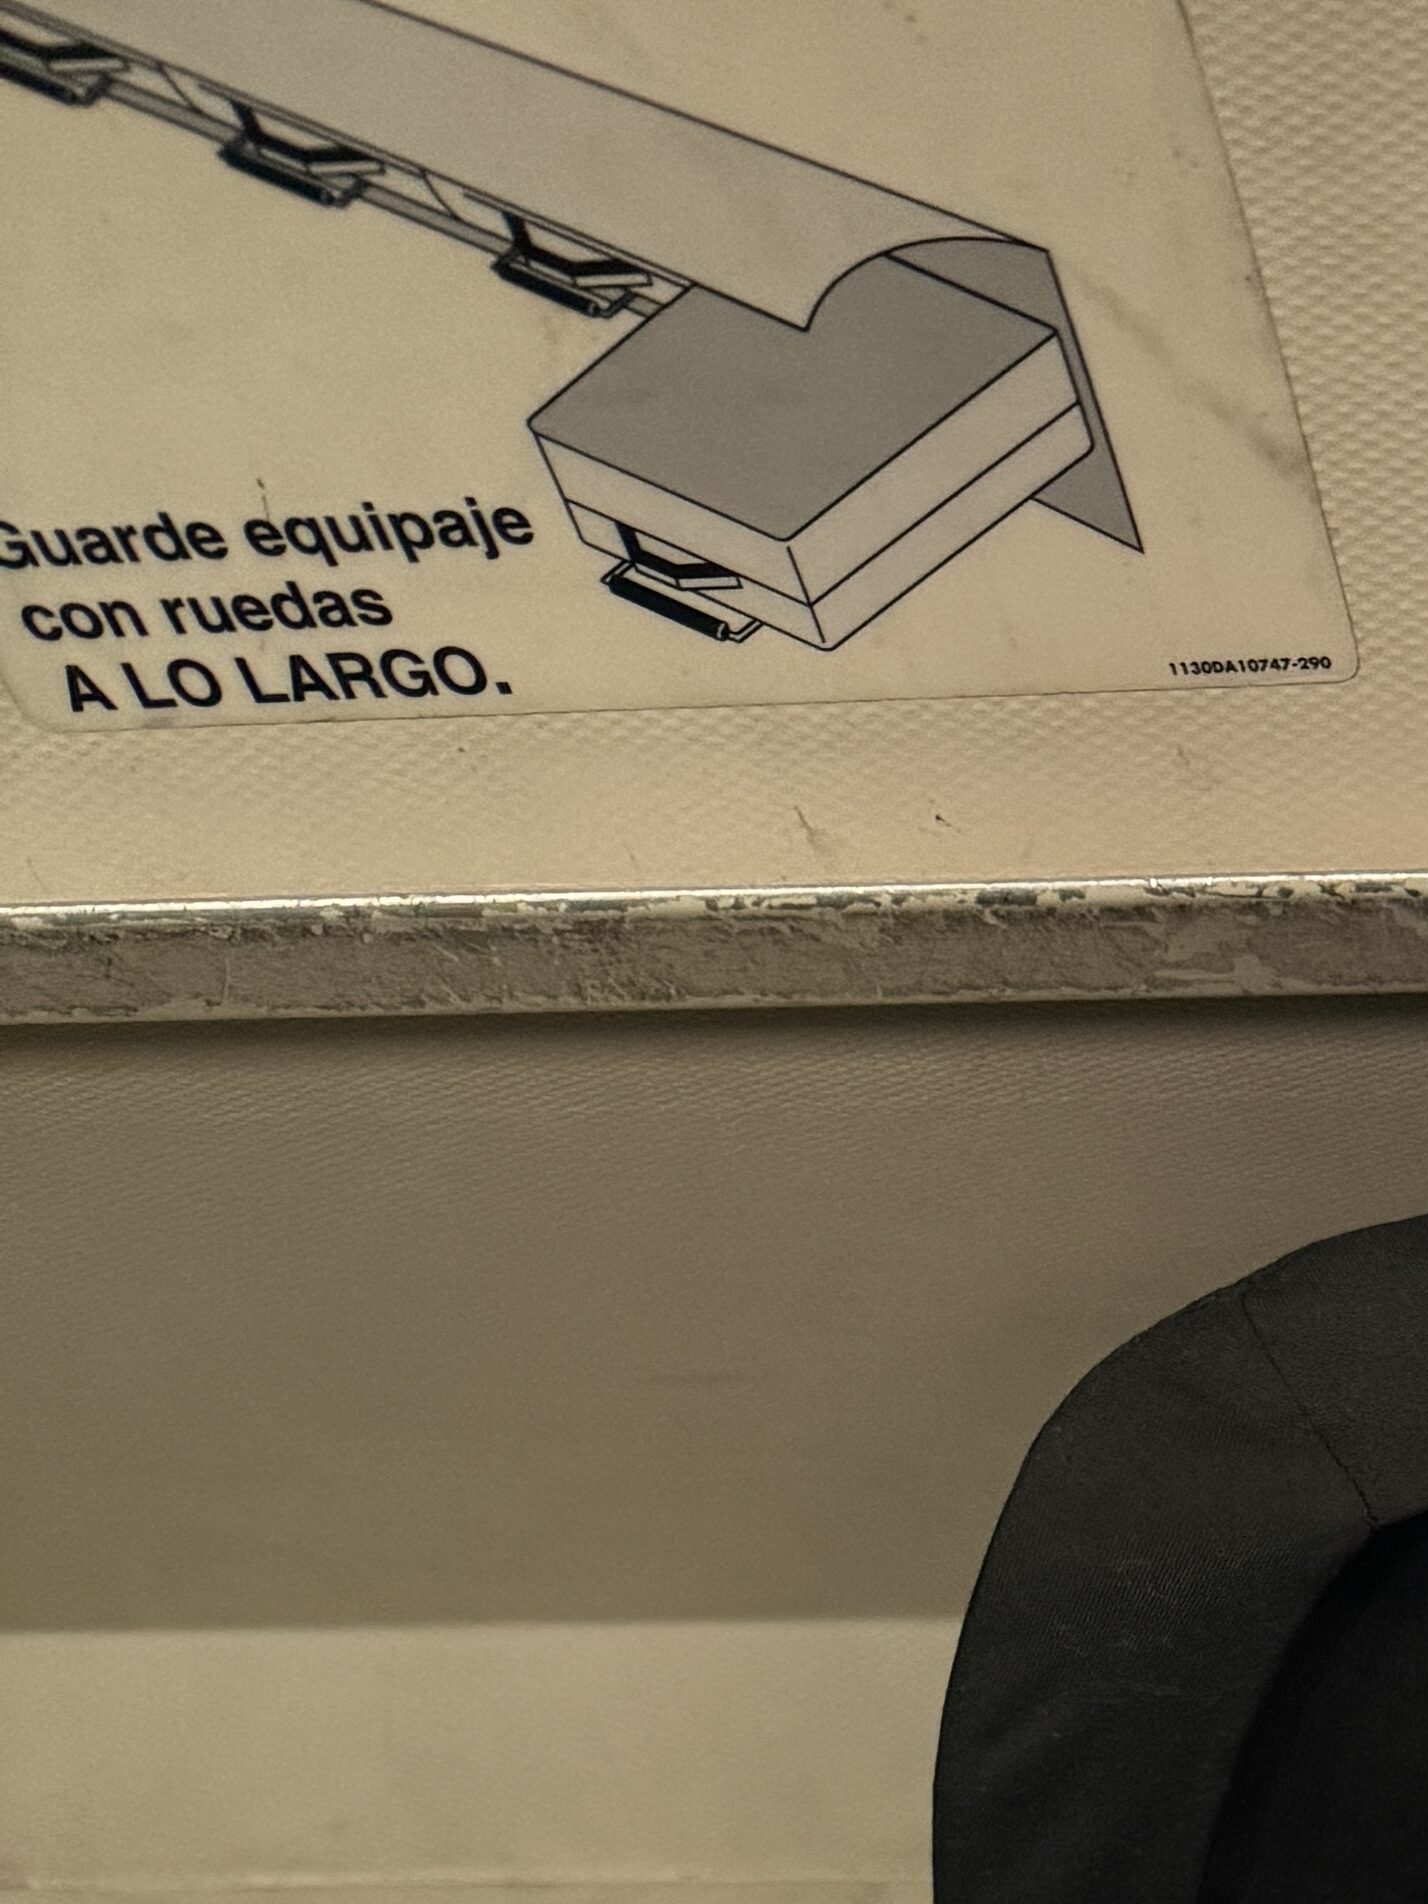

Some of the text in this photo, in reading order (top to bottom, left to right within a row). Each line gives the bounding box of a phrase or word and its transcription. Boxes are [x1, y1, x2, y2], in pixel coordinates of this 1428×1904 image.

[0, 496, 534, 570] Guarde equipaje
[20, 580, 394, 642] con ruedas
[65, 645, 513, 713] A LO LARGO.
